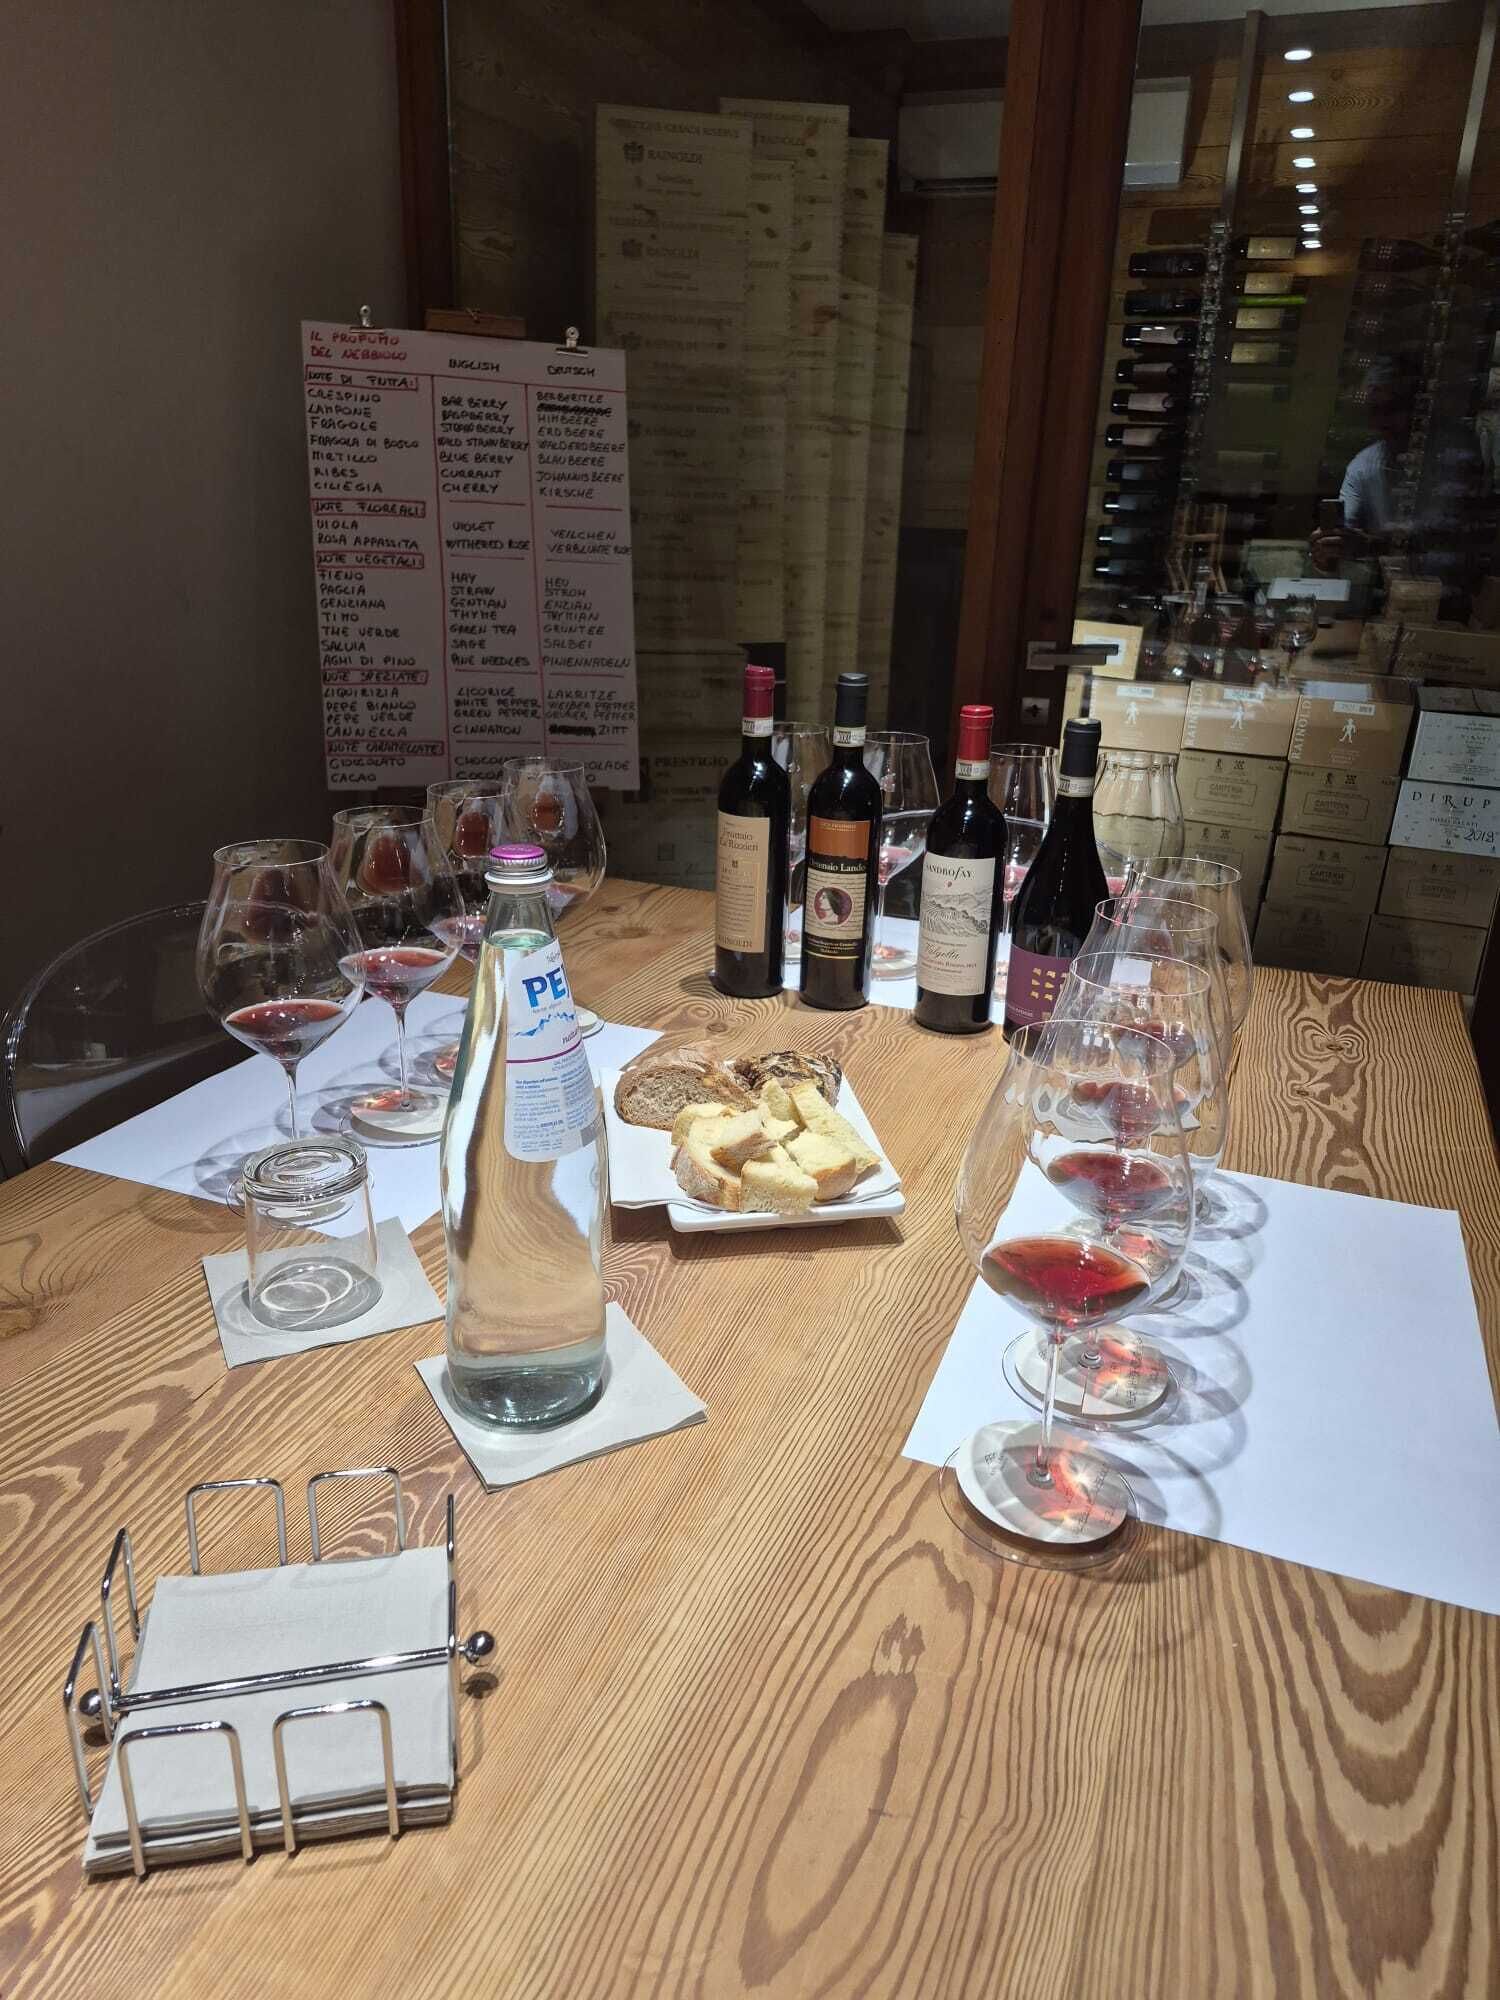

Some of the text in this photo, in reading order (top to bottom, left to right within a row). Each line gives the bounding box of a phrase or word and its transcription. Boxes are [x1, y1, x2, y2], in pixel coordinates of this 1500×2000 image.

[311, 346, 331, 358] DEL
[307, 388, 381, 403] CRESPINO
[308, 404, 371, 418] LAMPONE
[311, 416, 377, 431] FRAGOLE
[312, 451, 377, 463] MIRTILLO
[314, 467, 358, 478] RIBES
[314, 481, 383, 493] CILIEGIA
[442, 483, 499, 494] CHERRY
[451, 571, 477, 585] HAY
[319, 583, 366, 596] PAGLIA
[320, 598, 387, 610] GENZIANA
[491, 624, 517, 636] TEA
[323, 655, 417, 667] AGHI DI PINO
[330, 773, 377, 783] CACAO
[840, 863, 866, 873] Lando
